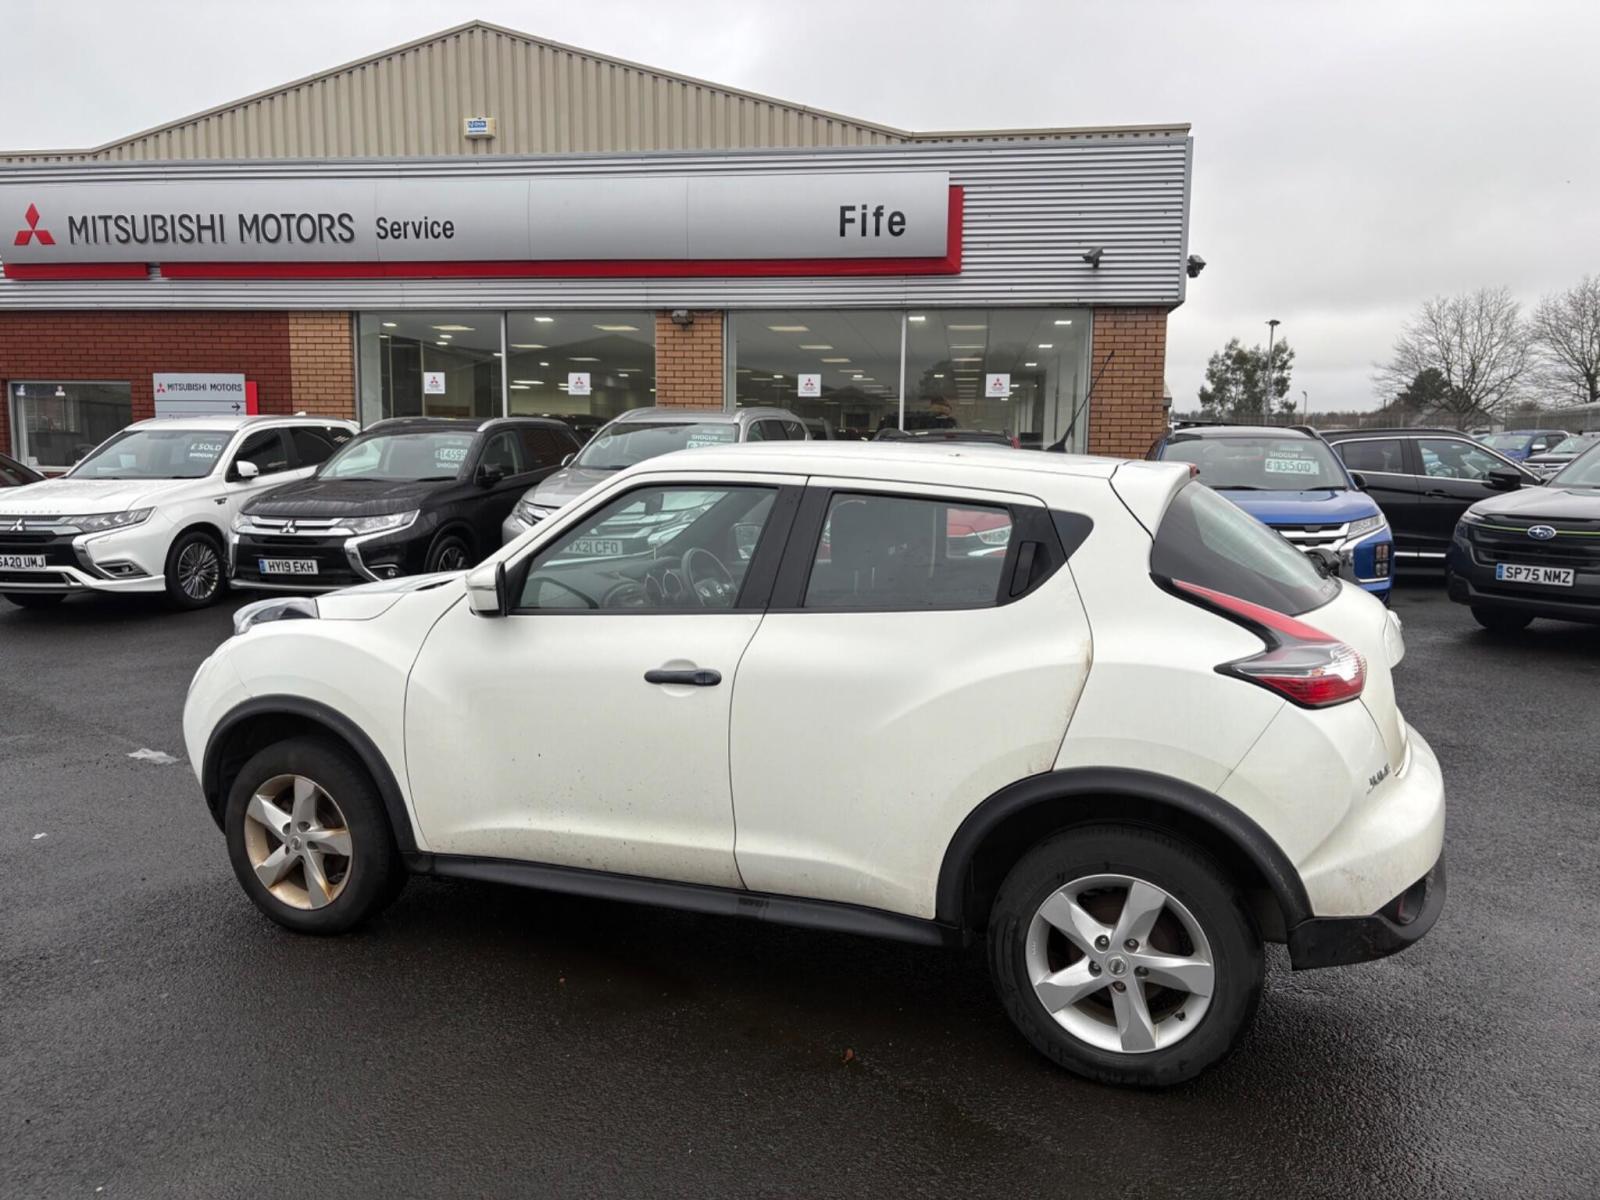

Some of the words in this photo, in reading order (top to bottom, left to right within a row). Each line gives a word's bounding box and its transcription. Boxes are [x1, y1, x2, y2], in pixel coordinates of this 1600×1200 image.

[840, 204, 906, 237] Fife
[68, 214, 226, 244] MITSUBISHI
[238, 213, 355, 243] MOTORS
[376, 216, 455, 240] Service
[167, 383, 207, 392] MITSUBISHI
[210, 383, 243, 392] MOTORS
[1270, 451, 1299, 459] SHOGUN
[24, 557, 44, 568] UMJ
[268, 561, 291, 571] HY19
[293, 561, 315, 572] EKH
[1506, 566, 1540, 581] SP75
[1544, 569, 1571, 584] NMZ
